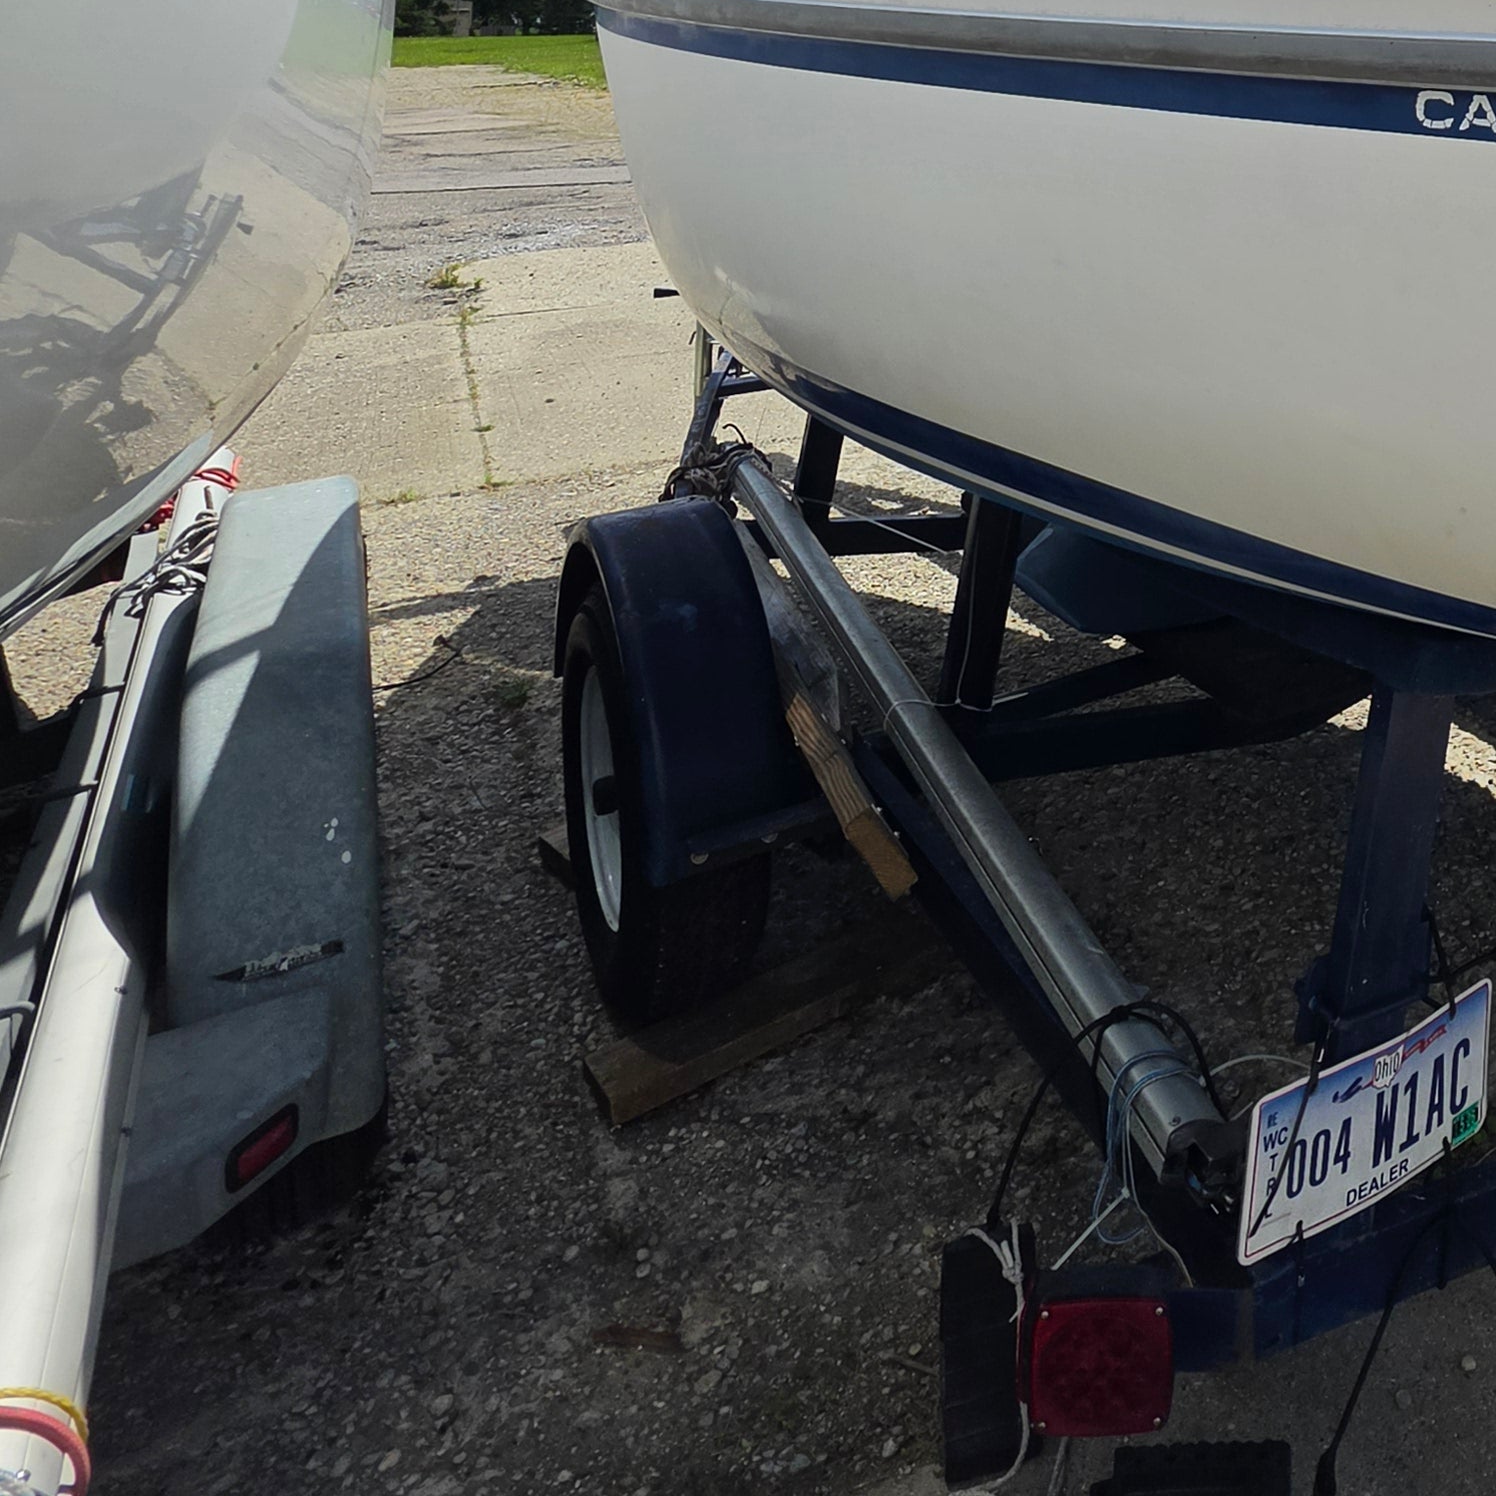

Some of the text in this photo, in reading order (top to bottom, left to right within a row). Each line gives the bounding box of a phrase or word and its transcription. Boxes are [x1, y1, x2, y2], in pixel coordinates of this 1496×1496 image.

[1263, 1127, 1289, 1153] WC
[1286, 1037, 1471, 1199] 004 W1AC
[1346, 1158, 1410, 1207] DEALER
